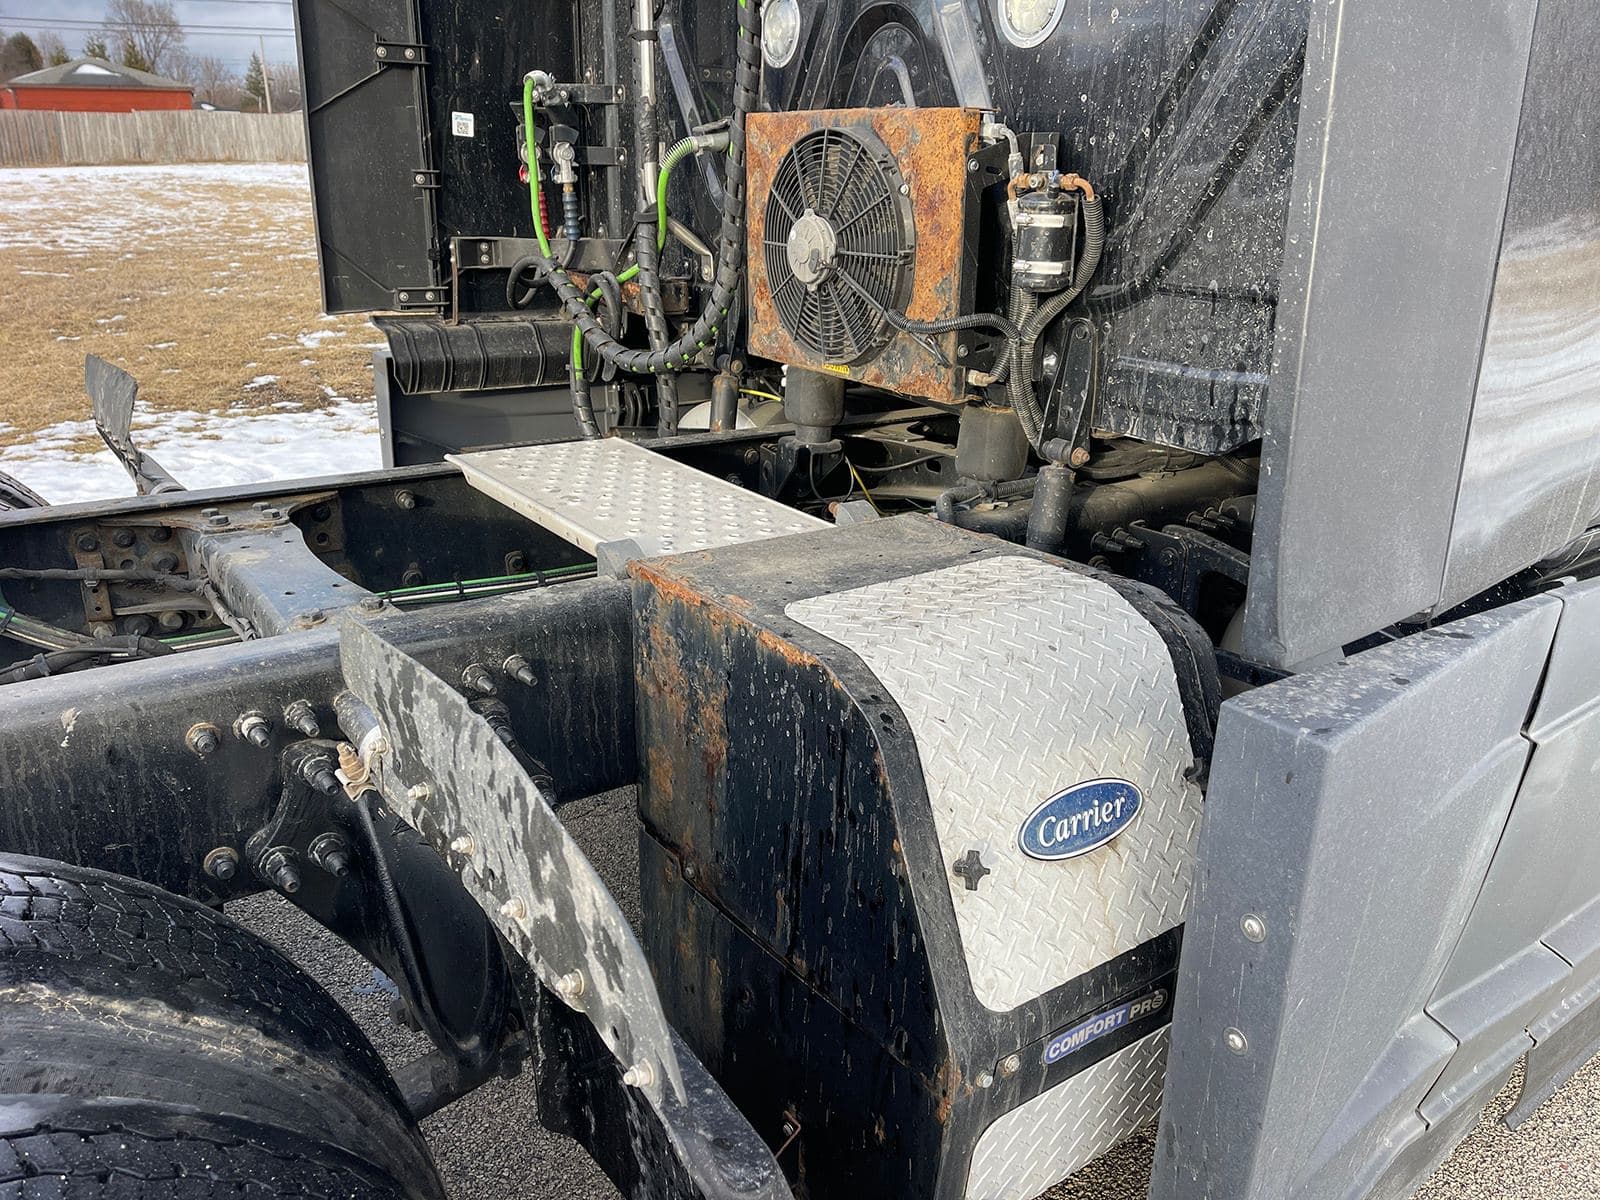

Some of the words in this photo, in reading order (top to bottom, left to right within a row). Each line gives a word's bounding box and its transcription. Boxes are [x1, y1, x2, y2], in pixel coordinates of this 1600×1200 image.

[1039, 796, 1125, 847] Carrier
[1048, 1009, 1126, 1059] COMFORT
[1129, 993, 1164, 1019] PRO
